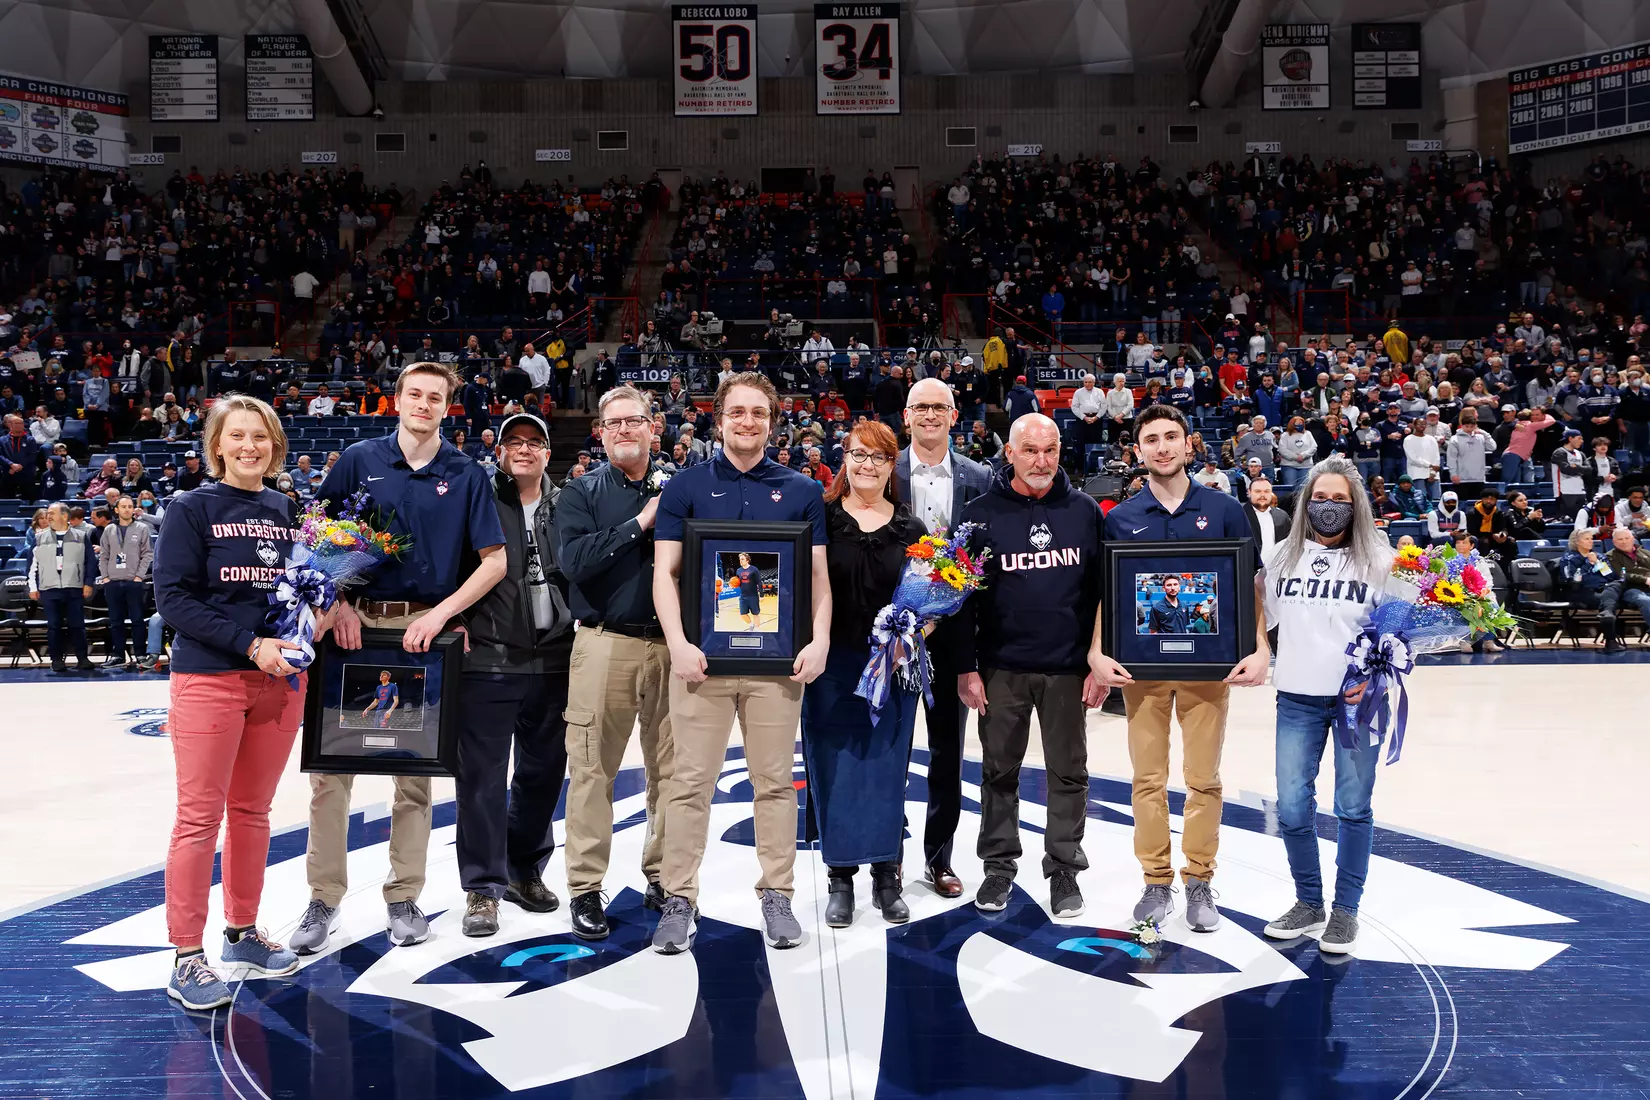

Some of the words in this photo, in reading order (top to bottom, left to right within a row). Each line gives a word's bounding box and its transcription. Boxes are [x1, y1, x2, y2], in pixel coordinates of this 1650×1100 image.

[681, 7, 721, 18] REBECCA
[724, 7, 748, 18] LOBO
[832, 7, 851, 17] RAY
[854, 6, 882, 16] ALLEN
[162, 36, 204, 44] NATIONAL
[257, 36, 300, 44] NATIONAL
[680, 24, 750, 82] 50
[822, 23, 893, 82] 34
[1513, 70, 1539, 83] BIG
[1548, 59, 1590, 75] EAST
[1513, 74, 1570, 92] REGULAR
[1577, 63, 1628, 80] SEASON
[1541, 86, 1562, 101] 1994
[1571, 80, 1592, 96] 1995
[1600, 74, 1622, 90] 1996
[1631, 69, 1650, 84] 199
[28, 83, 126, 105] CHAMPIONSH
[24, 93, 60, 105] FINAL
[67, 99, 98, 111] FOUR
[1512, 109, 1534, 124] 2003
[1541, 104, 1563, 119] 2005
[1570, 98, 1593, 114] 2006
[1515, 132, 1592, 151] CONNECTICUT
[1598, 125, 1632, 138] MEN'S
[1024, 145, 1042, 154] 210
[1265, 143, 1280, 151] 211
[1424, 141, 1441, 150] 212
[143, 155, 164, 163] 206
[316, 153, 336, 161] 207
[550, 151, 570, 159] 208
[45, 158, 87, 169] WOMEN'S
[621, 371, 638, 379] SEC
[641, 369, 670, 381] 109
[1062, 368, 1086, 380] 110
[211, 523, 289, 540] UNIVERSITY
[290, 528, 302, 542] O
[1000, 547, 1081, 572] UCONN
[252, 581, 275, 589] HUSK
